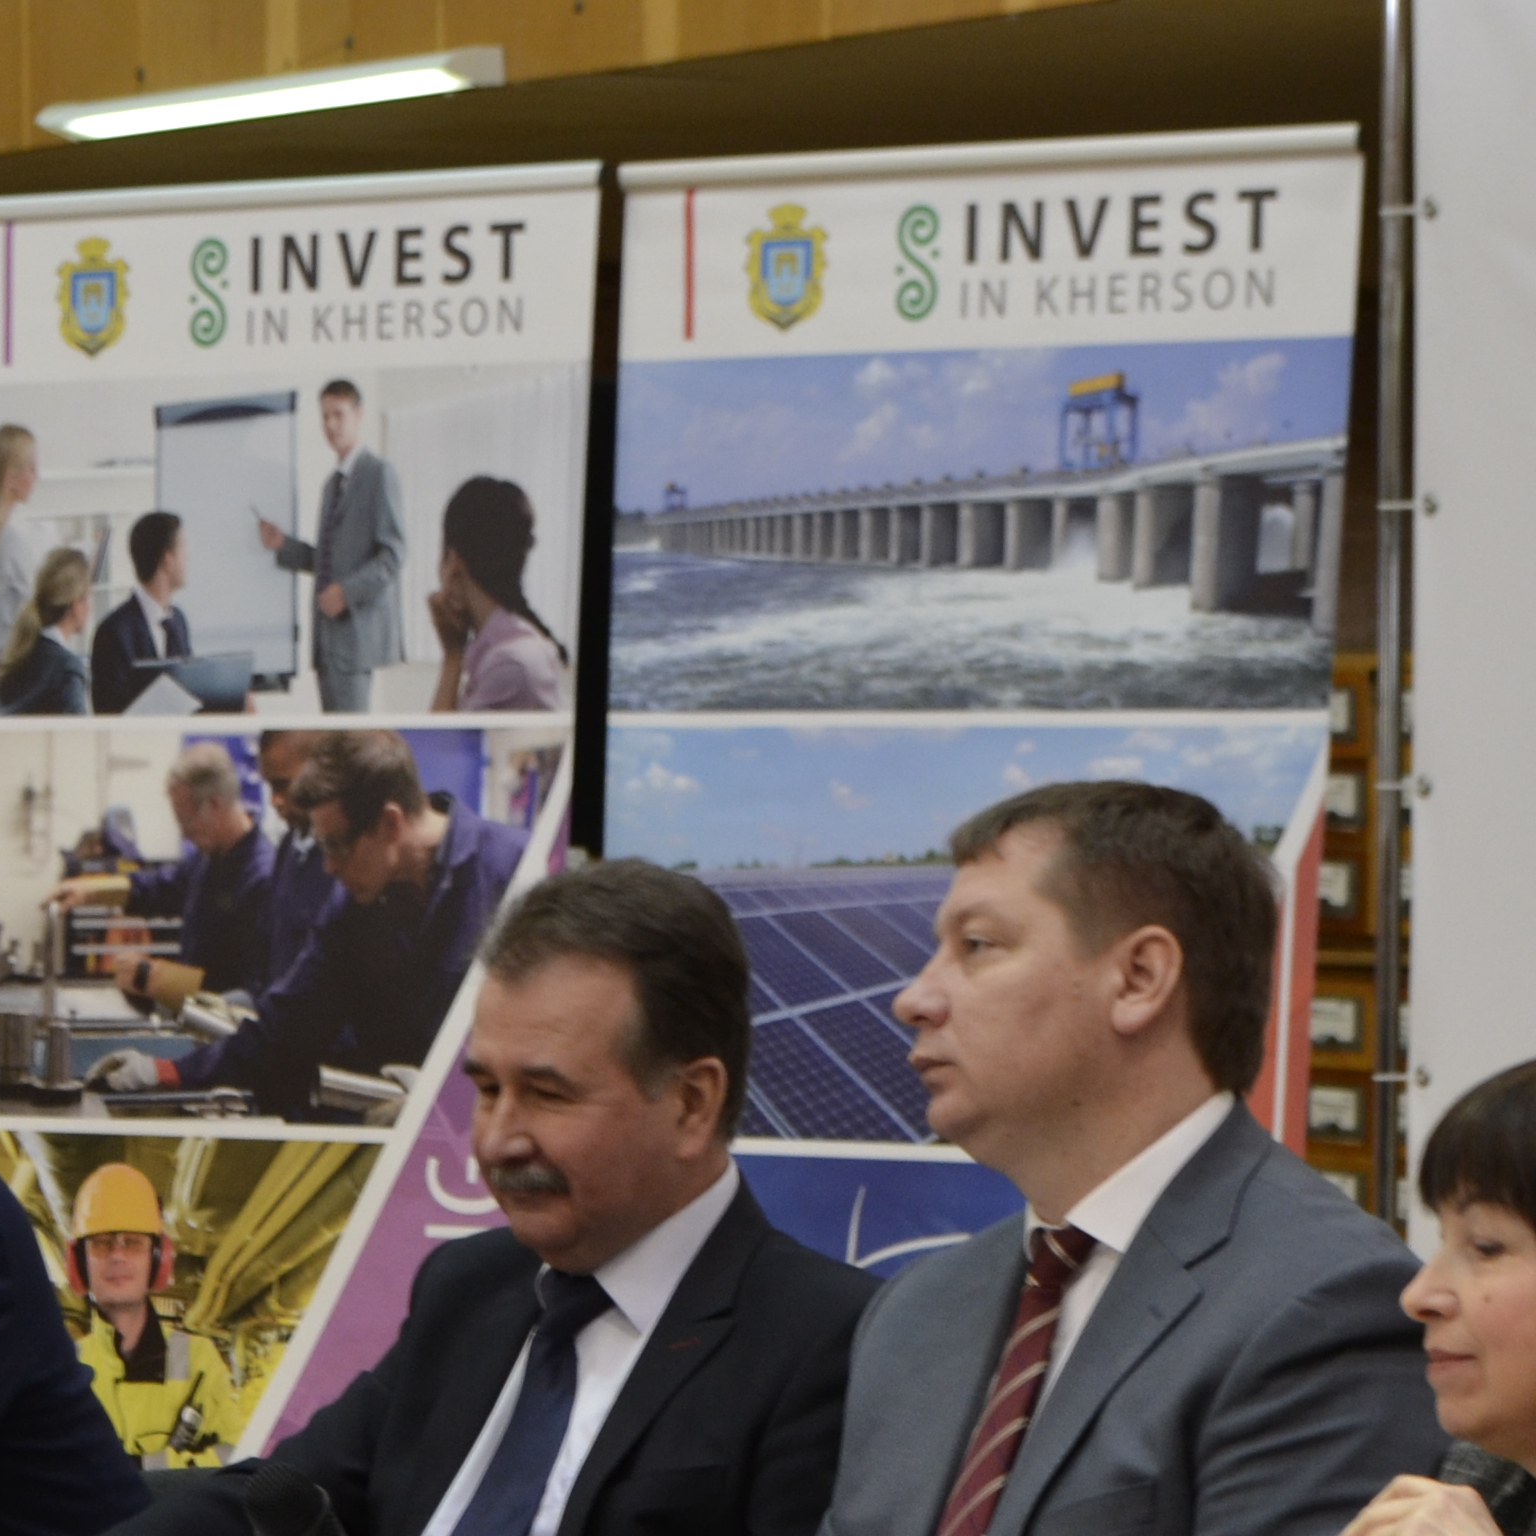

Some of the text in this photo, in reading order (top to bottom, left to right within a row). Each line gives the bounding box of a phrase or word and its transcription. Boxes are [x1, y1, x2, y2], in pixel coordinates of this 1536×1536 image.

[249, 222, 526, 292] INVEST
[964, 190, 1279, 264] INVEST
[245, 296, 526, 346] IN KHERSON
[959, 268, 1276, 318] IN KHERSON
